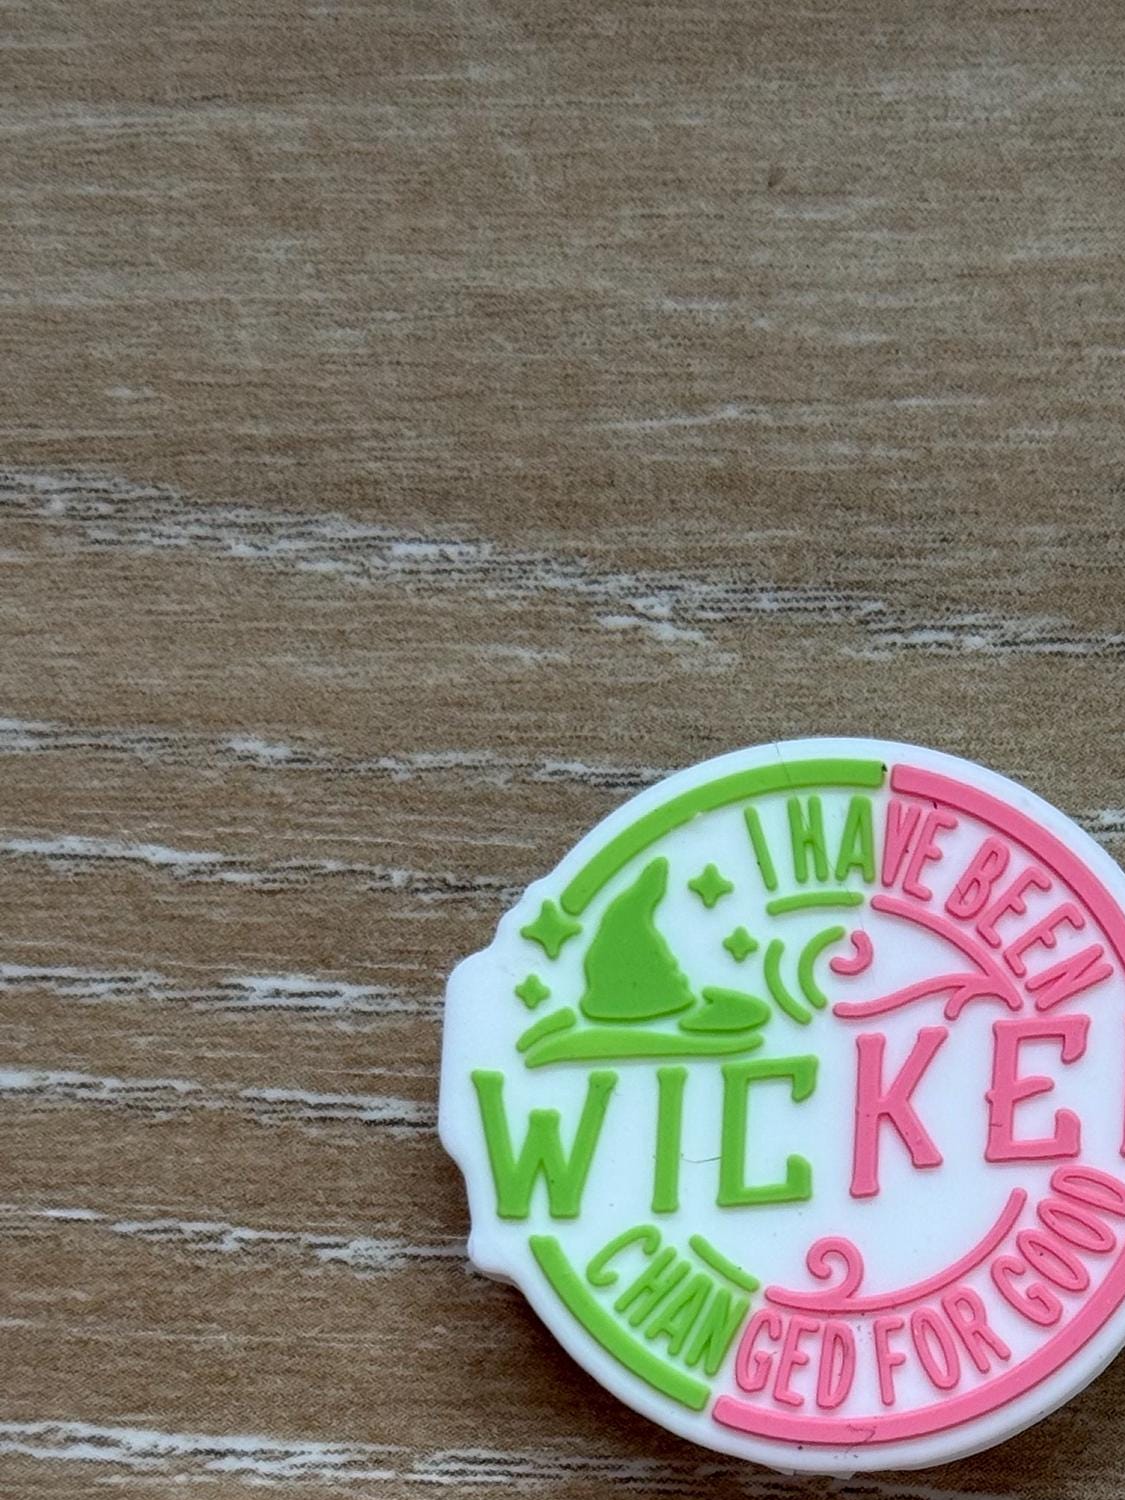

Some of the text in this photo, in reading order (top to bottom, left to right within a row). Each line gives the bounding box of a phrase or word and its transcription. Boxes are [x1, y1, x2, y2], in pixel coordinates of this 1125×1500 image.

[744, 793, 1114, 1012] I HAVE BEEN
[585, 1224, 856, 1410] CHANGED
[873, 1288, 1012, 1404] FOR
